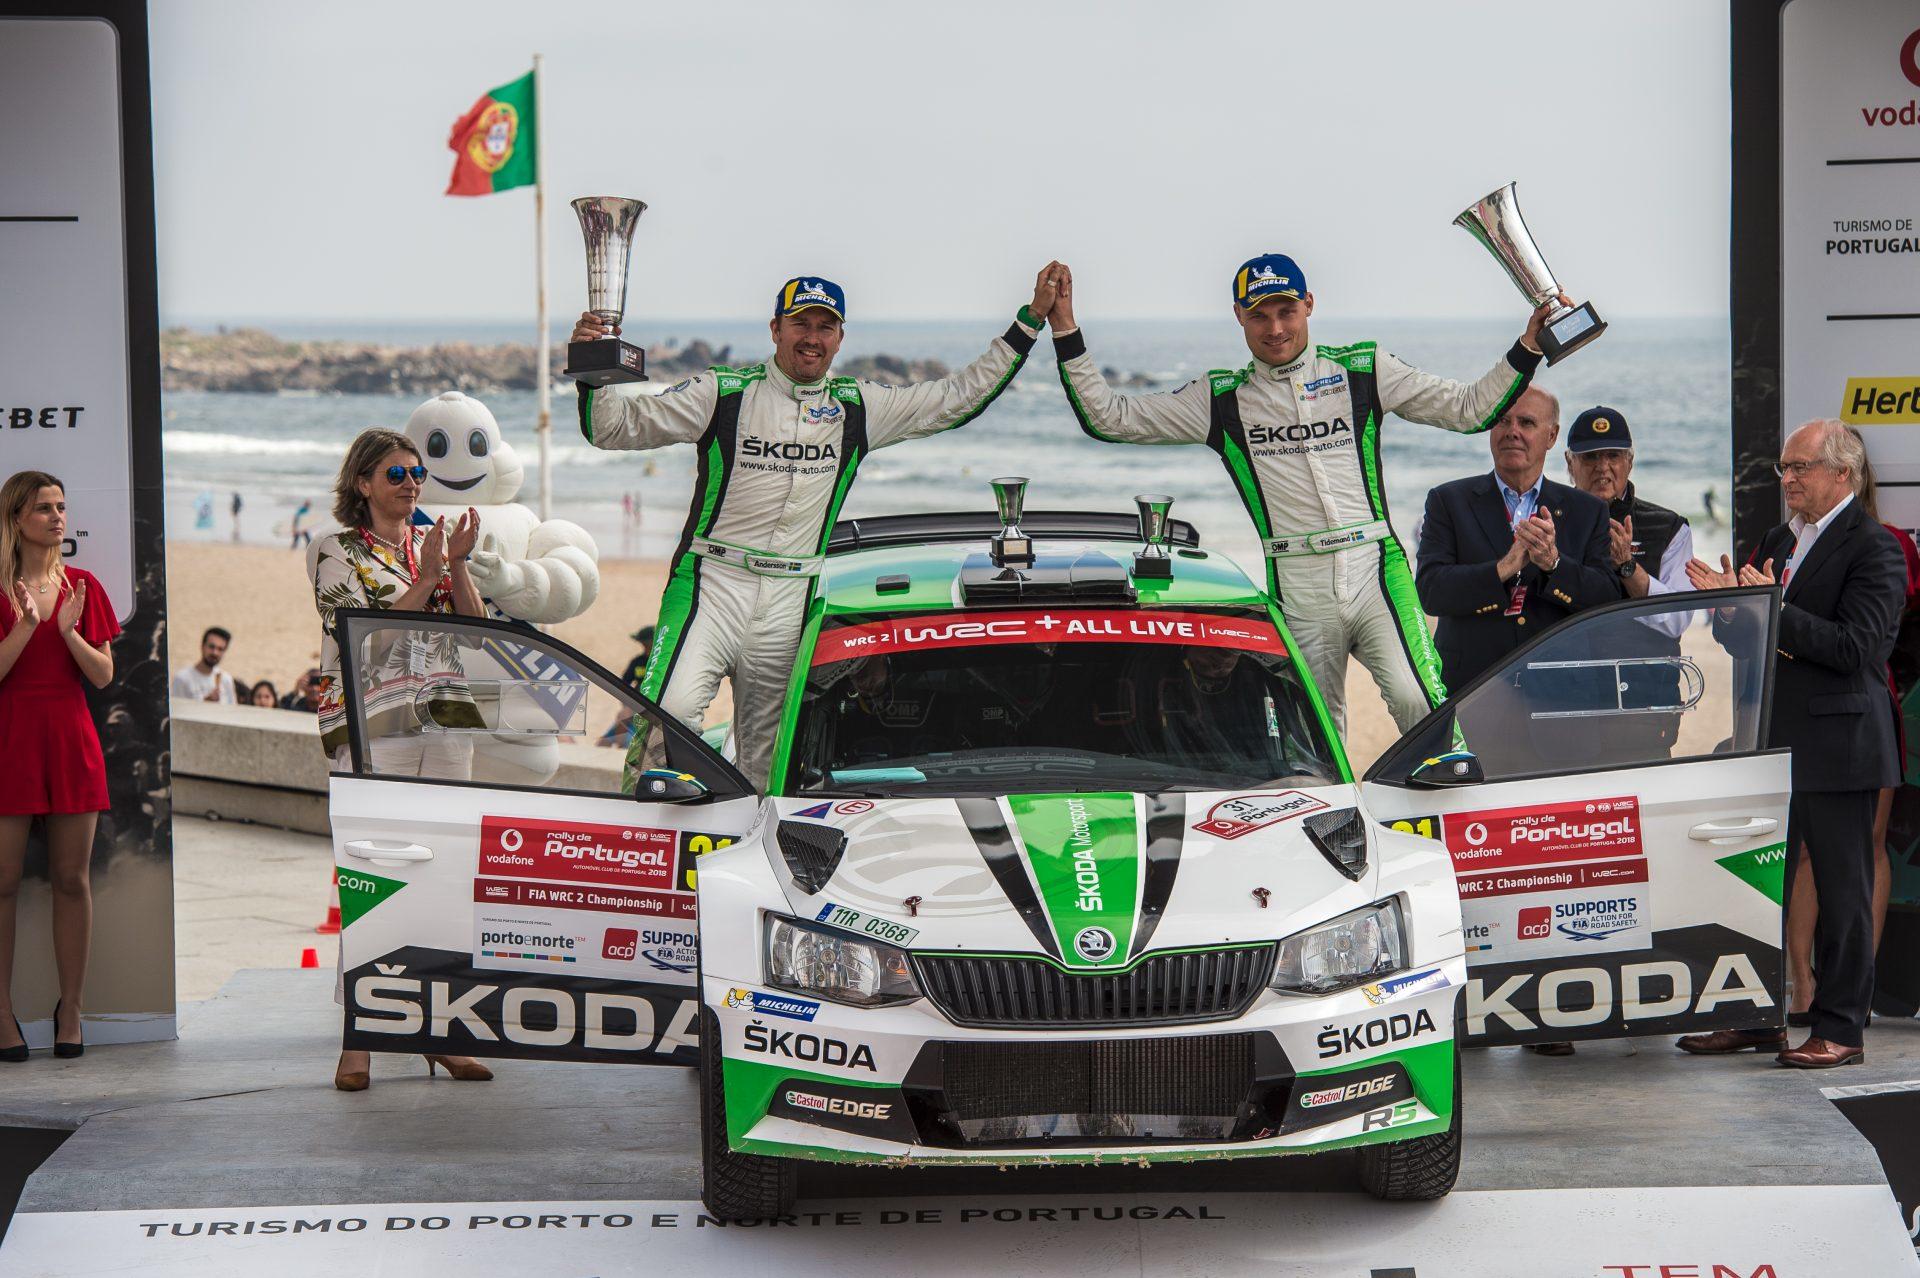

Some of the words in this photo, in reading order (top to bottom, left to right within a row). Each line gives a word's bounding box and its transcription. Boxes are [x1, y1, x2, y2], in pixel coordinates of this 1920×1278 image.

[1861, 100, 1920, 127] vod
[1833, 220, 1892, 233] TURISMO
[1895, 219, 1913, 231] DE
[1248, 278, 1289, 292] MICHELIN
[794, 294, 837, 307] MICHELIN
[1351, 356, 1371, 366] OMP
[721, 379, 743, 388] OMP
[1214, 378, 1235, 388] OMP
[1249, 417, 1350, 444] ŠKODA
[742, 436, 838, 461] ŠKODA
[1252, 437, 1354, 457] www.skoda-auto.com
[740, 460, 836, 475] www.skoda-auto.com
[1271, 541, 1289, 552] OMP
[1320, 534, 1351, 547] Tidemand
[708, 545, 726, 557] OMP
[754, 560, 787, 569] Andersson
[843, 634, 877, 648] WRC
[880, 633, 890, 643] 2
[904, 620, 1027, 643] WRC
[1066, 619, 1122, 635] ALL
[1130, 620, 1195, 637] LIVE
[887, 703, 920, 716] OMP
[1223, 800, 1254, 812] 31
[1240, 797, 1313, 823] Portugal
[1067, 799, 1093, 847] Motorsport
[1511, 816, 1539, 827] rally
[1541, 814, 1555, 823] de
[547, 832, 575, 842] rally
[577, 833, 592, 842] de
[1510, 817, 1635, 844] Portugal
[1616, 836, 1636, 845] 2018
[486, 854, 535, 866] vodafone
[544, 841, 668, 868] Portugal
[1454, 847, 1503, 860] vodafone
[648, 869, 668, 877] 2018
[1073, 849, 1103, 912] ŠKODA
[1459, 881, 1484, 893] WRC
[1487, 880, 1493, 890] 2
[1497, 872, 1573, 889] Championship
[528, 889, 546, 900] FIA
[550, 890, 573, 902] WRC
[577, 892, 584, 902] 2
[587, 894, 663, 911] Championship
[1555, 898, 1637, 918] SUPPORTS
[833, 908, 860, 927] 11R
[864, 919, 910, 942] 0368
[1572, 920, 1588, 929] FIA
[1591, 914, 1617, 922] ACTION
[1591, 921, 1611, 929] ROAD
[1611, 919, 1638, 928] SAFETY
[1523, 923, 1549, 936] acp
[481, 930, 575, 949] portoenorte
[607, 944, 634, 958] acp
[657, 949, 673, 958] FIA
[758, 998, 818, 1016] MICHELIN
[1316, 1008, 1437, 1060] ŠKODA
[744, 1019, 877, 1073] ŠKODA
[1312, 1089, 1342, 1105] Castrol
[1343, 1073, 1397, 1101] EDGE
[796, 1093, 825, 1109] Castrol
[828, 1098, 893, 1120] EDGE
[1362, 1100, 1418, 1132] R5
[139, 1217, 368, 1238] TURISMO
[384, 1216, 450, 1231] DO
[468, 1214, 633, 1230] PORTO
[651, 1214, 679, 1228] E
[880, 1209, 942, 1225] DE
[960, 1205, 1226, 1223] PORTUGAL
